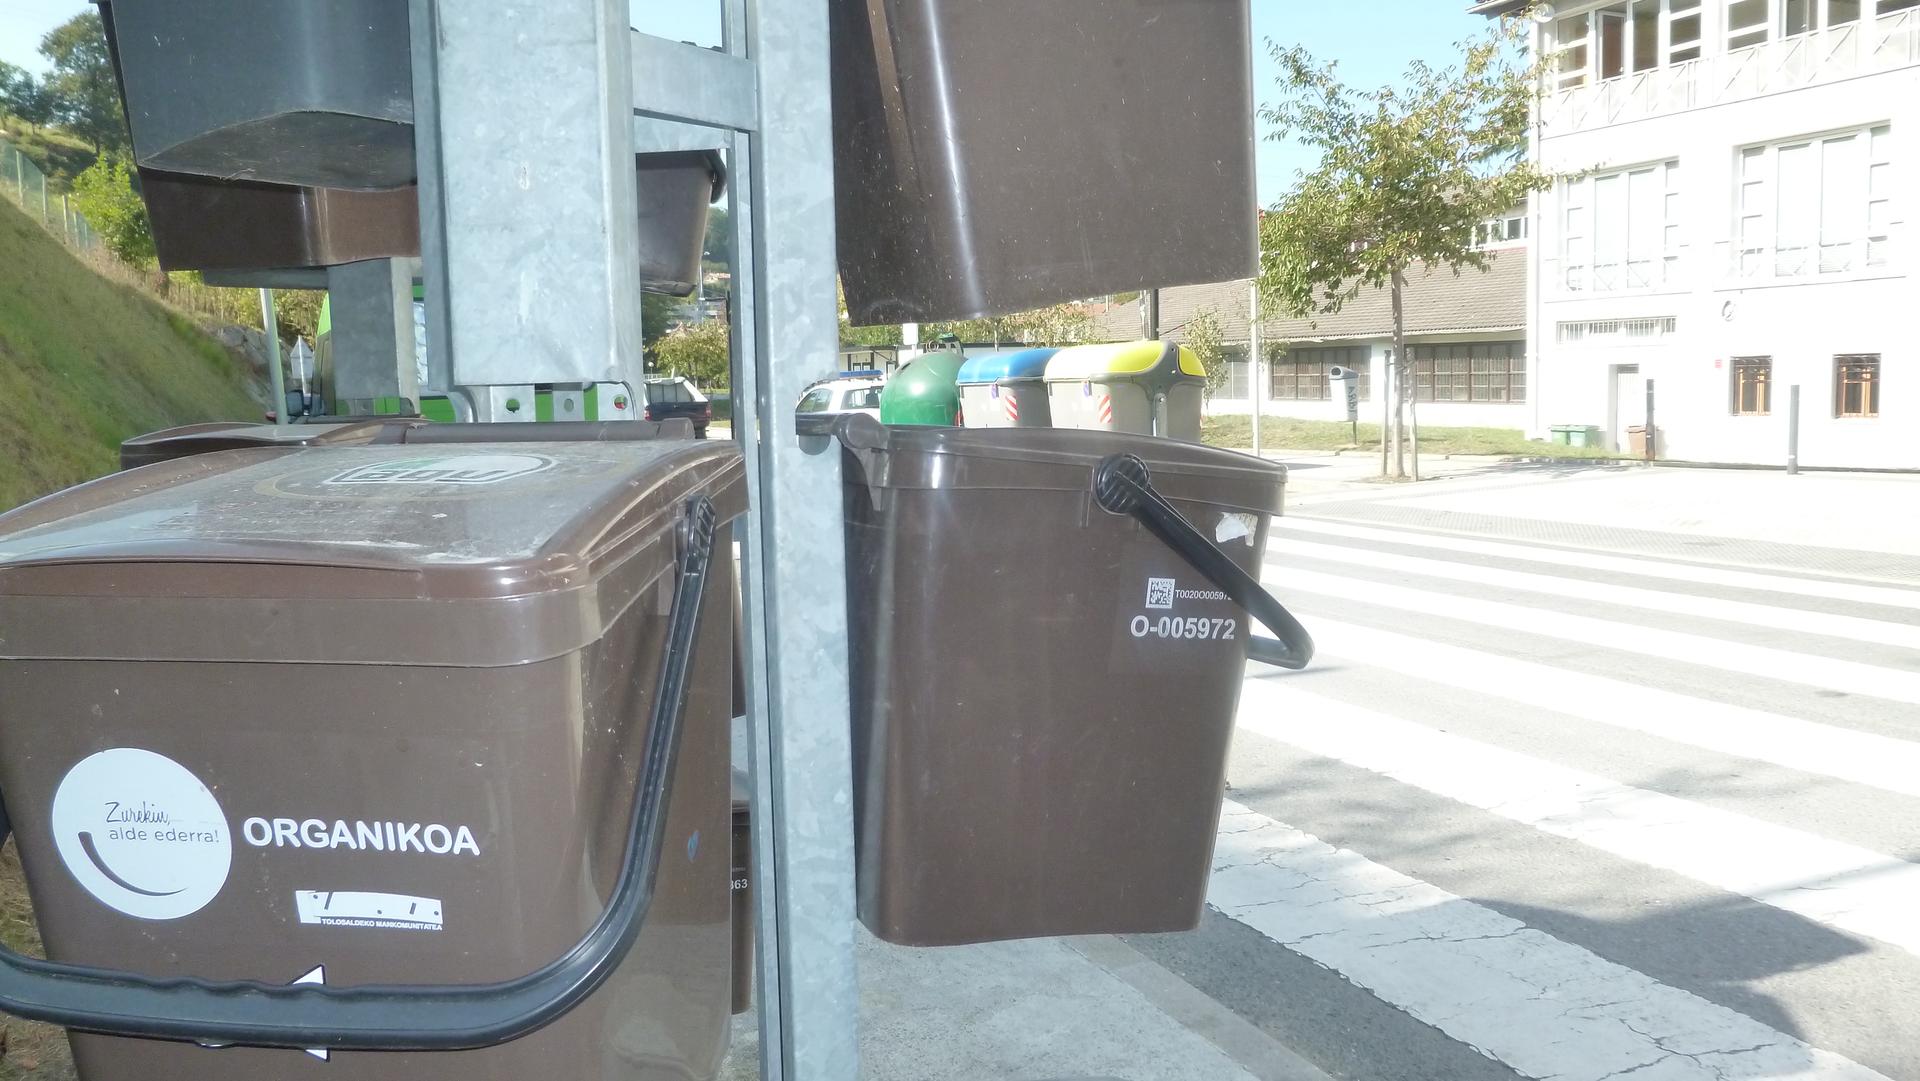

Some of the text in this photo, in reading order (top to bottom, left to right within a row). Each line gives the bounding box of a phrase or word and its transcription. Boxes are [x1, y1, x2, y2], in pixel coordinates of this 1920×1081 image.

[1130, 615, 1236, 640] O-005972
[104, 801, 170, 825] Zurekin,
[109, 827, 220, 843] alde ederra!
[243, 817, 480, 856] ORGANIKOA
[322, 918, 443, 931] TOLOSALDEKO MANKOMUNITATEA
